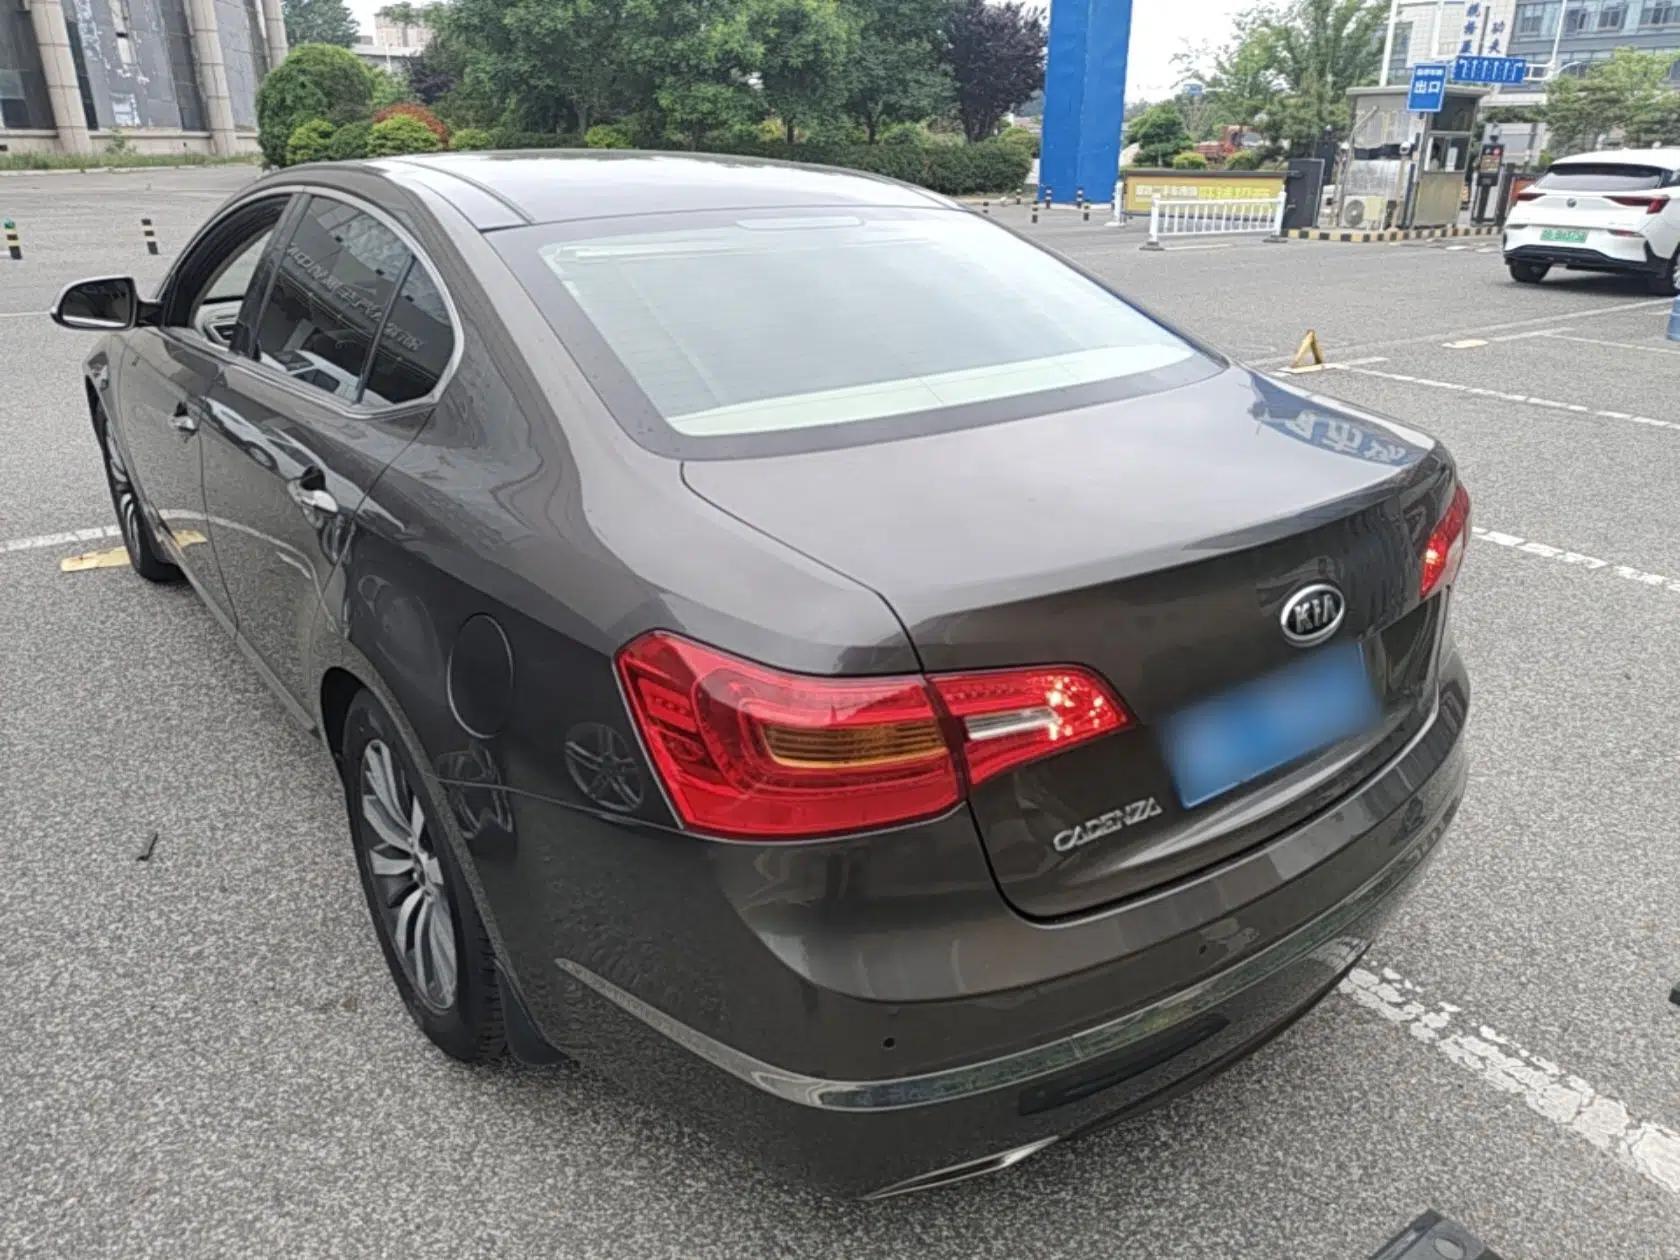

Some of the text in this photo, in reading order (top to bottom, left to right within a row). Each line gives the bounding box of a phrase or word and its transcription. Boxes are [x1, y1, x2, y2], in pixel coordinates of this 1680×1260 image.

[1414, 80, 1441, 94] 出口
[1294, 593, 1338, 633] KIA
[1052, 797, 1163, 851] CADENZA
